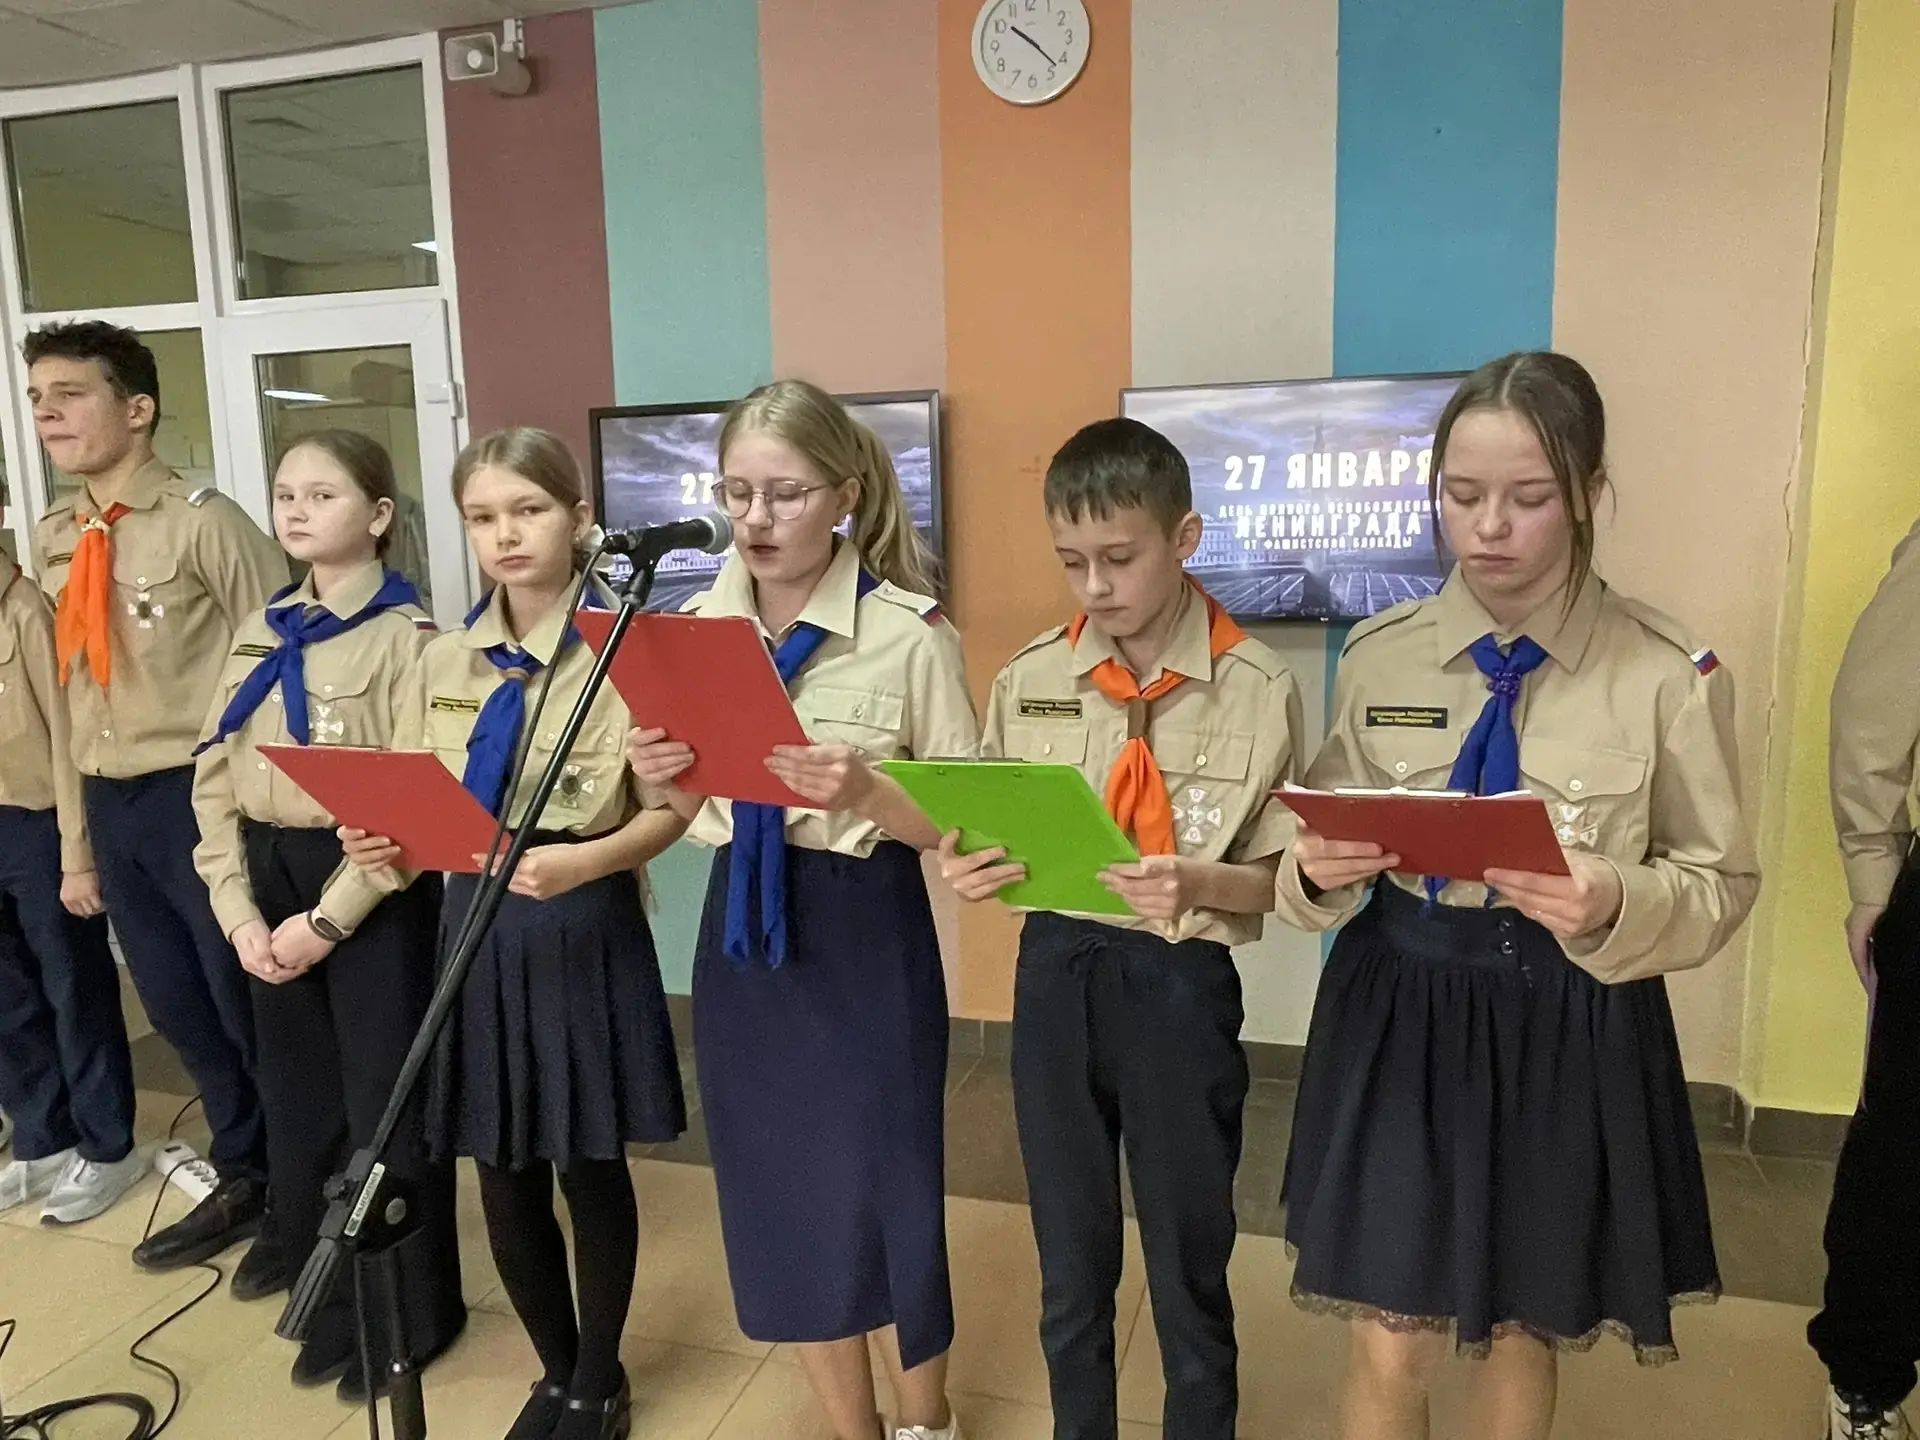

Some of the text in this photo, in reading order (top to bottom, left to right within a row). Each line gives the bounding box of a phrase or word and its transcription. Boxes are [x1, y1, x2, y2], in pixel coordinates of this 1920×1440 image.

[1009, 3, 1017, 18] 11
[1057, 10, 1066, 26] 2
[994, 18, 1006, 33] 10
[1065, 29, 1073, 45] 3
[990, 40, 999, 54] 9
[997, 58, 1005, 72] 8
[1058, 51, 1067, 64] 4
[1012, 70, 1021, 85] 7
[1047, 65, 1055, 81] 5
[1028, 74, 1037, 88] 6
[1224, 449, 1434, 491] 27 ЯНВАРЯ
[680, 472, 714, 505] 27
[1235, 512, 1422, 538] ЛЕНИНГРАДА
[1243, 539, 1257, 550] ОТ
